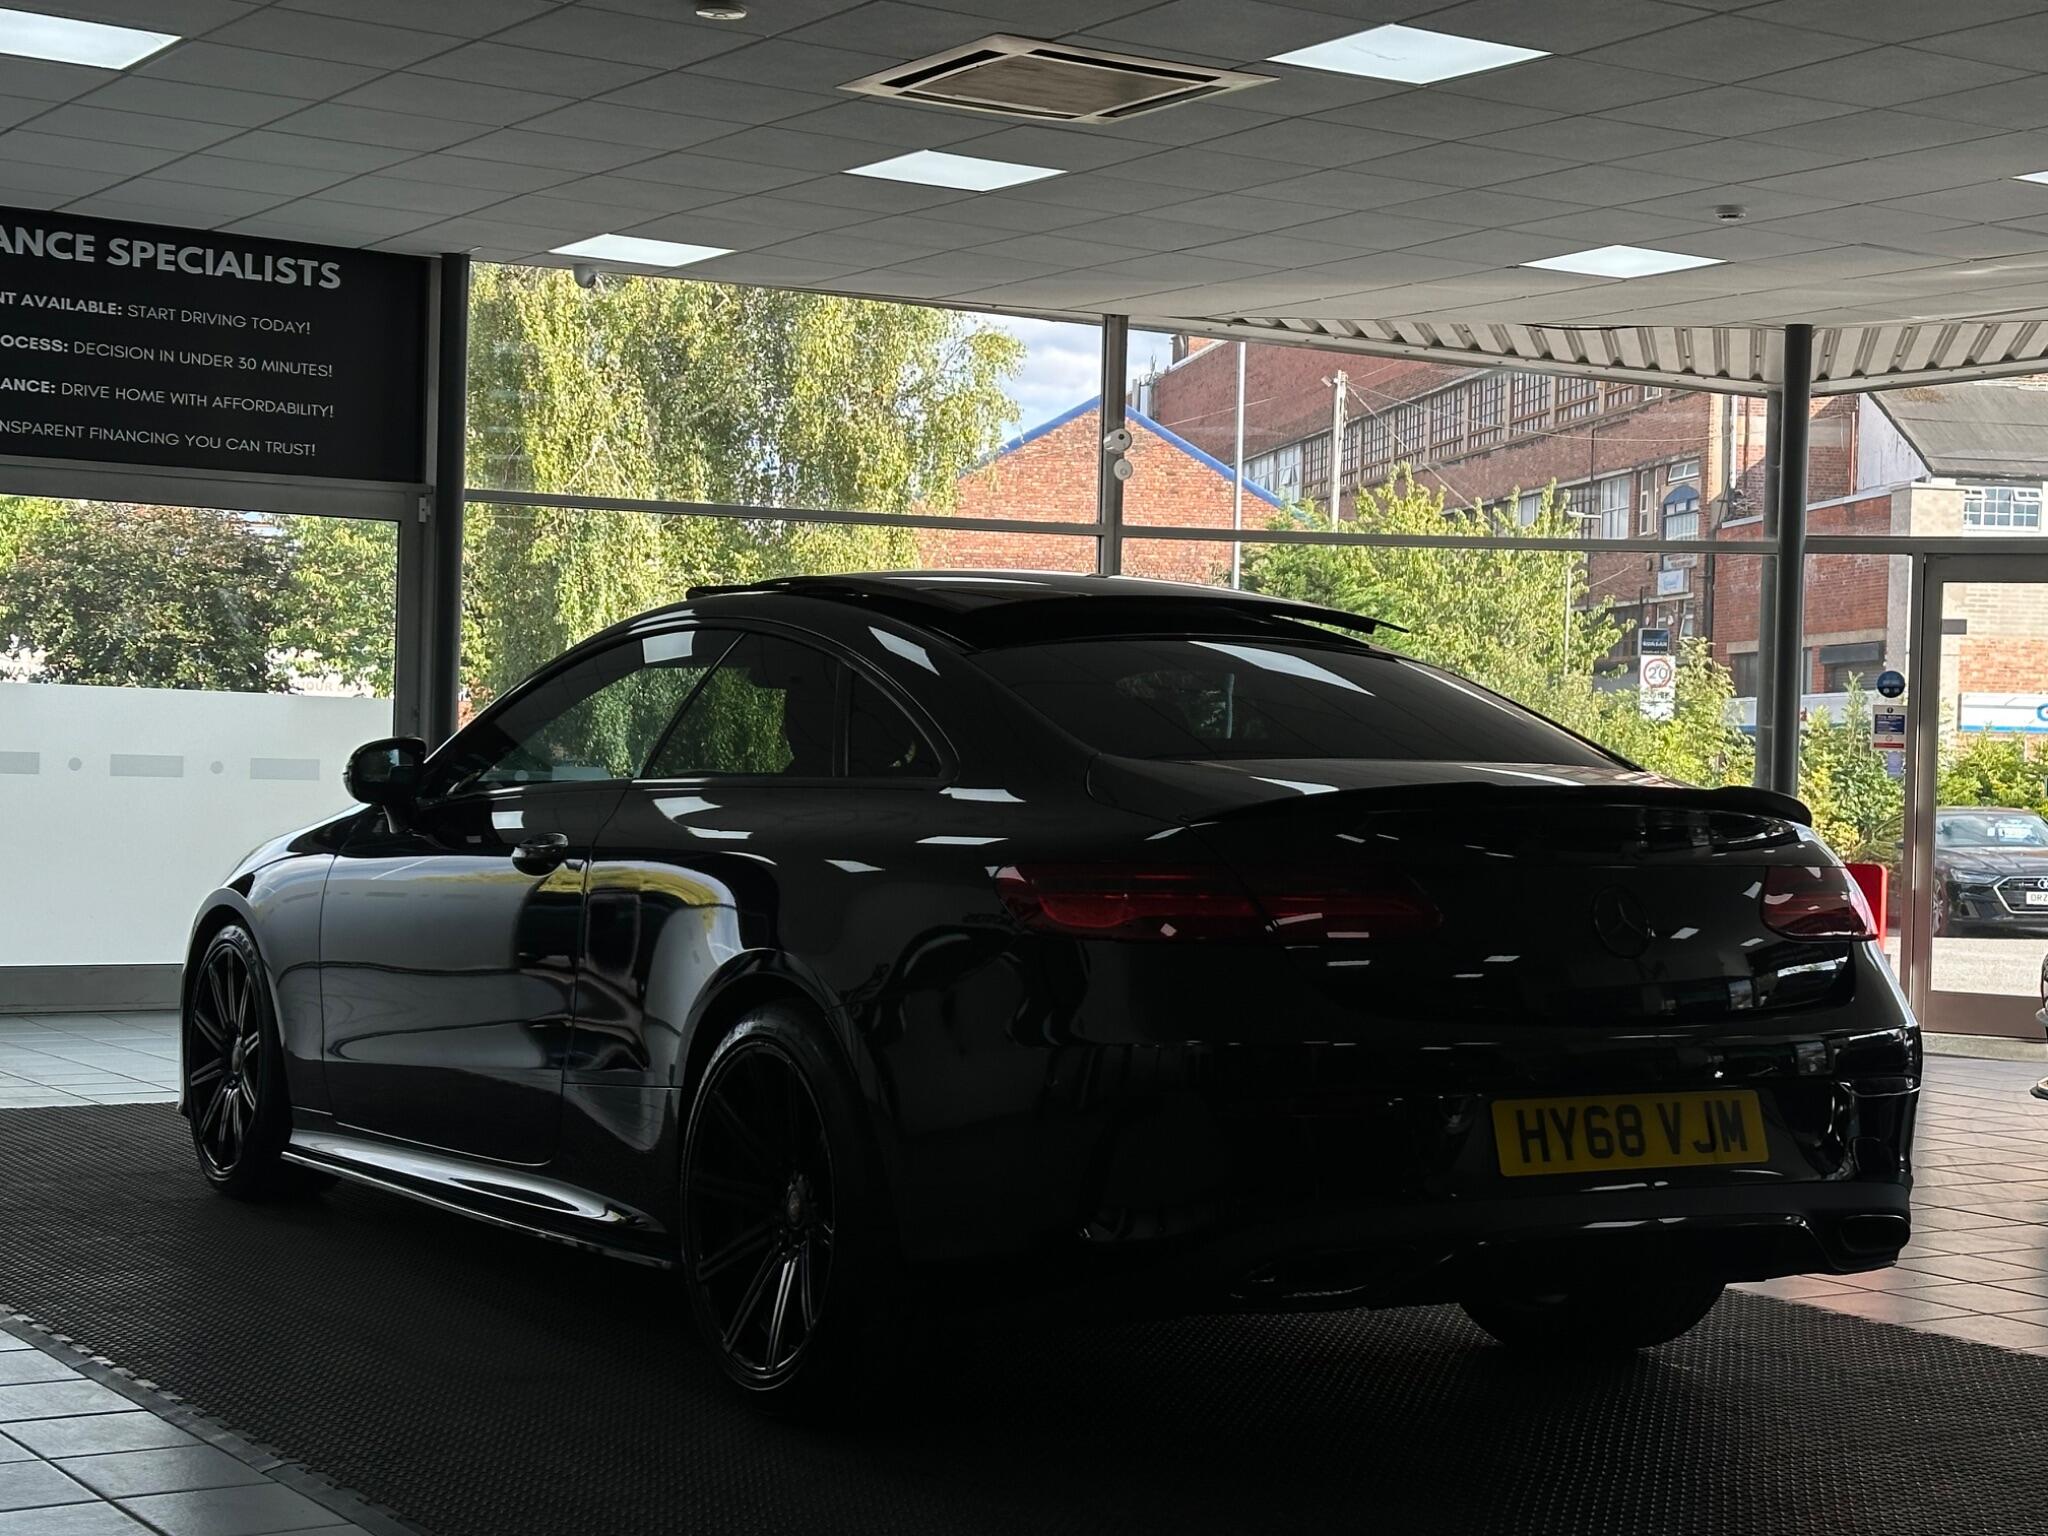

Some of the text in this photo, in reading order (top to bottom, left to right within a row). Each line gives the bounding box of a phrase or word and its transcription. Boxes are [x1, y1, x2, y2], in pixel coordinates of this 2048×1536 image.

[106, 237, 341, 289] SPECIALISTS
[20, 293, 123, 316] AVAILABLE:
[127, 304, 177, 321] START
[181, 309, 247, 328] DRIVING
[251, 316, 311, 335] TODAY!
[0, 334, 333, 378] OCESS: DECISION IN UNDER 30 MINUTES!
[0, 377, 334, 418] ANCE: DRIVE HOME WITH AFFORDABILITY!
[0, 419, 316, 457] NSPARENT FINANCING YOU CAN TRUST!
[1648, 666, 1668, 680] 20
[1516, 1099, 1748, 1163] HY68 VJM
